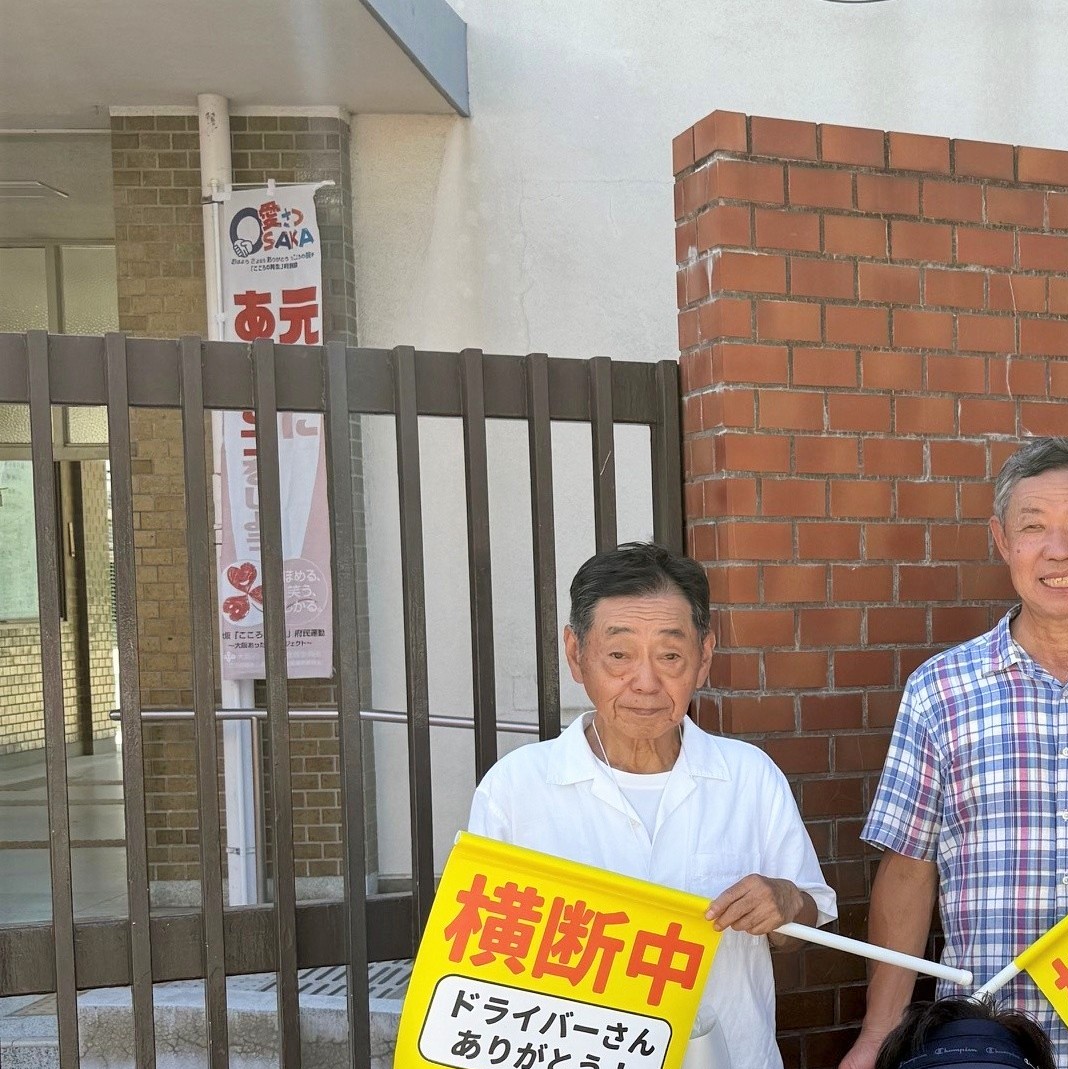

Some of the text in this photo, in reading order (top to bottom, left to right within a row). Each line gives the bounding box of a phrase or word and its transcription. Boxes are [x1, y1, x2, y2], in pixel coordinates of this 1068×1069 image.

[234, 290, 276, 342] あ
[279, 286, 319, 345] 元
[443, 874, 705, 1006] 横断中
[450, 989, 656, 1057] ドライバーさん
